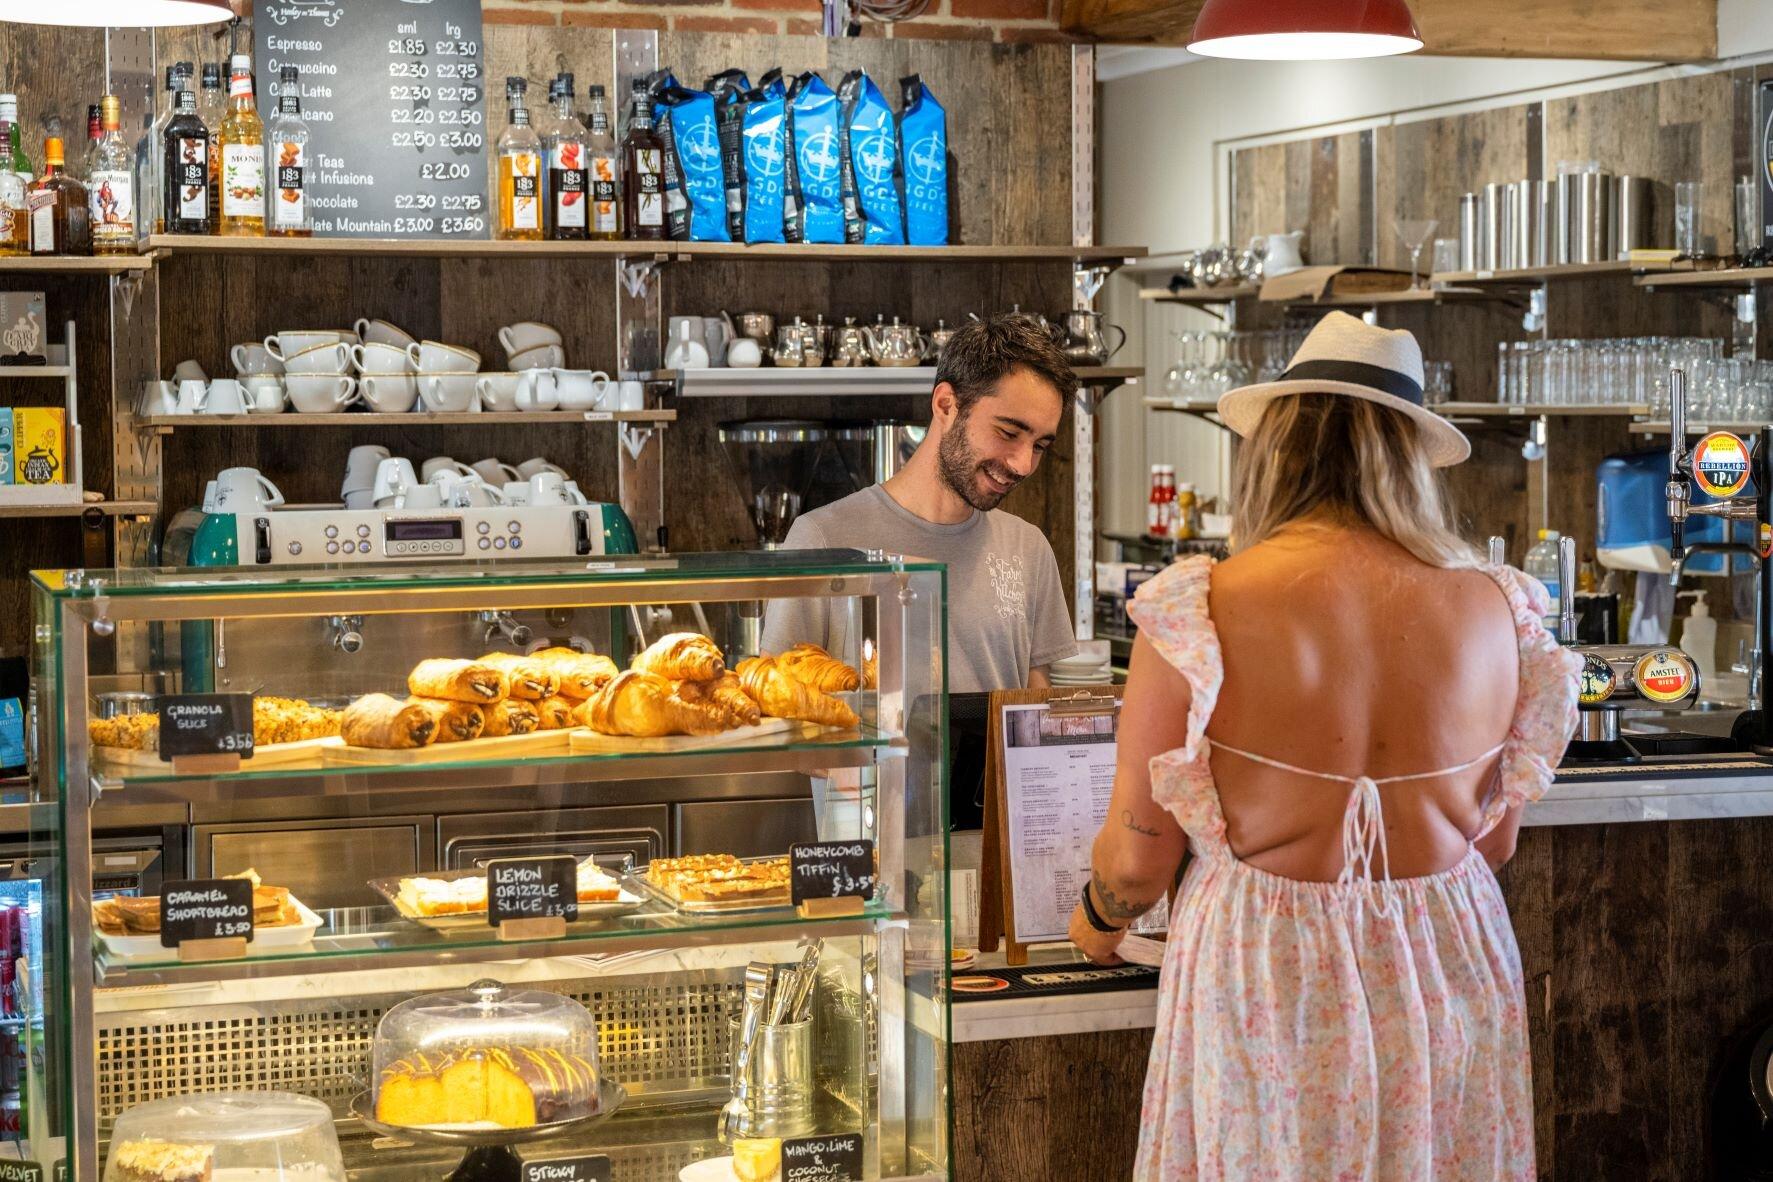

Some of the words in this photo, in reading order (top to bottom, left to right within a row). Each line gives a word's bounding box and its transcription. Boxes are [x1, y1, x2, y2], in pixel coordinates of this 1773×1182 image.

[397, 20, 417, 34] sml
[446, 21, 461, 39] lrg
[268, 35, 322, 54] Espresso
[388, 39, 425, 54] £1.85
[435, 41, 477, 55] £2.30
[437, 64, 478, 78] £2.75
[301, 83, 332, 98] Latte
[390, 86, 431, 100] £2.30
[438, 87, 477, 101] £2.75
[270, 106, 334, 121] Aicano
[391, 109, 434, 123] £2.20
[438, 109, 482, 125] £2.50
[392, 130, 435, 147] £2.50
[440, 131, 482, 147] £3.00
[317, 154, 345, 169] Teas
[320, 170, 374, 186] Infusions
[422, 163, 470, 179] £2.00
[394, 194, 436, 209] £2.30
[441, 194, 481, 210] £2.75
[336, 218, 392, 233] Mountain
[393, 217, 434, 233] £3.00
[441, 216, 484, 233] £3.60
[27, 470, 51, 480] TEA
[1713, 472, 1732, 486] IPA
[167, 704, 223, 719] GRANOLA
[177, 719, 208, 729] SLICE
[795, 845, 864, 858] HONEYCOMB
[495, 866, 542, 884] LEMON
[167, 889, 228, 905] CARAMEL
[497, 898, 542, 911] SLICE
[166, 905, 249, 922] SHORTBREAD
[214, 922, 251, 936] £3.50
[814, 1154, 823, 1165] &
[788, 1163, 841, 1178] COCONUT
